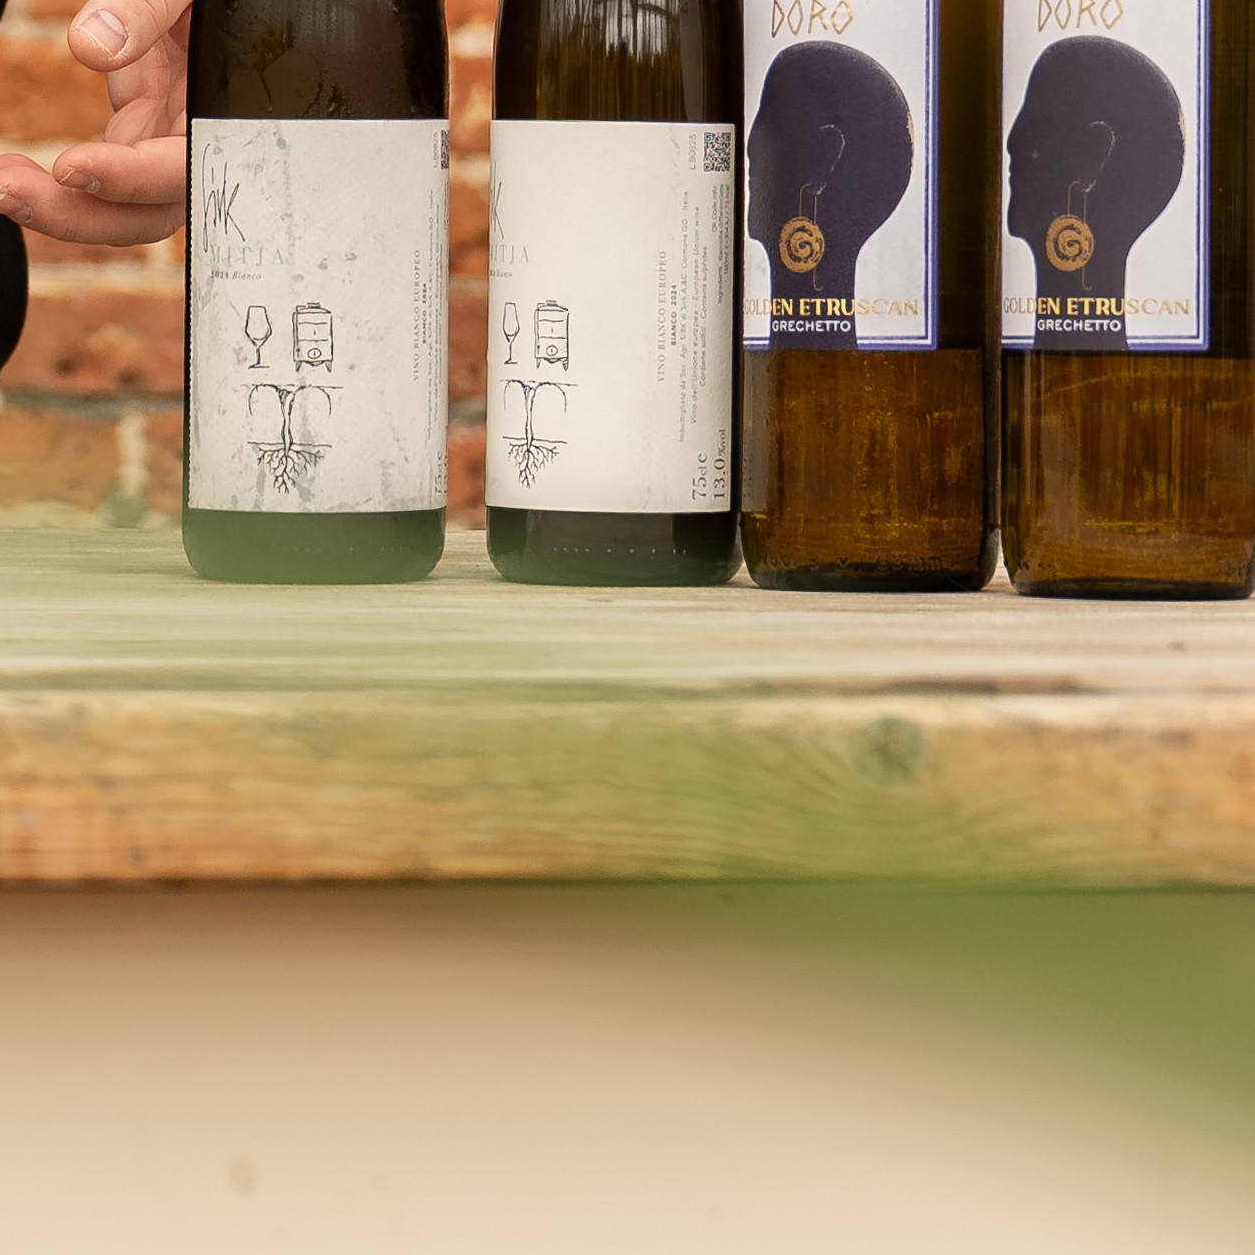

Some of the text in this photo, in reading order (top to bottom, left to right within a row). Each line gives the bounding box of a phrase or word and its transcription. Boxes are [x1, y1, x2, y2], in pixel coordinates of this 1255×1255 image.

[209, 244, 286, 267] MITJA
[799, 297, 919, 316] ETRUSCAN
[1003, 296, 1190, 316] GOLDEN ETRUSCAN
[657, 250, 667, 383] VINO BIANCO EUROPEO
[1036, 319, 1122, 332] GRECHETTO
[771, 320, 852, 333] GRECHETTO
